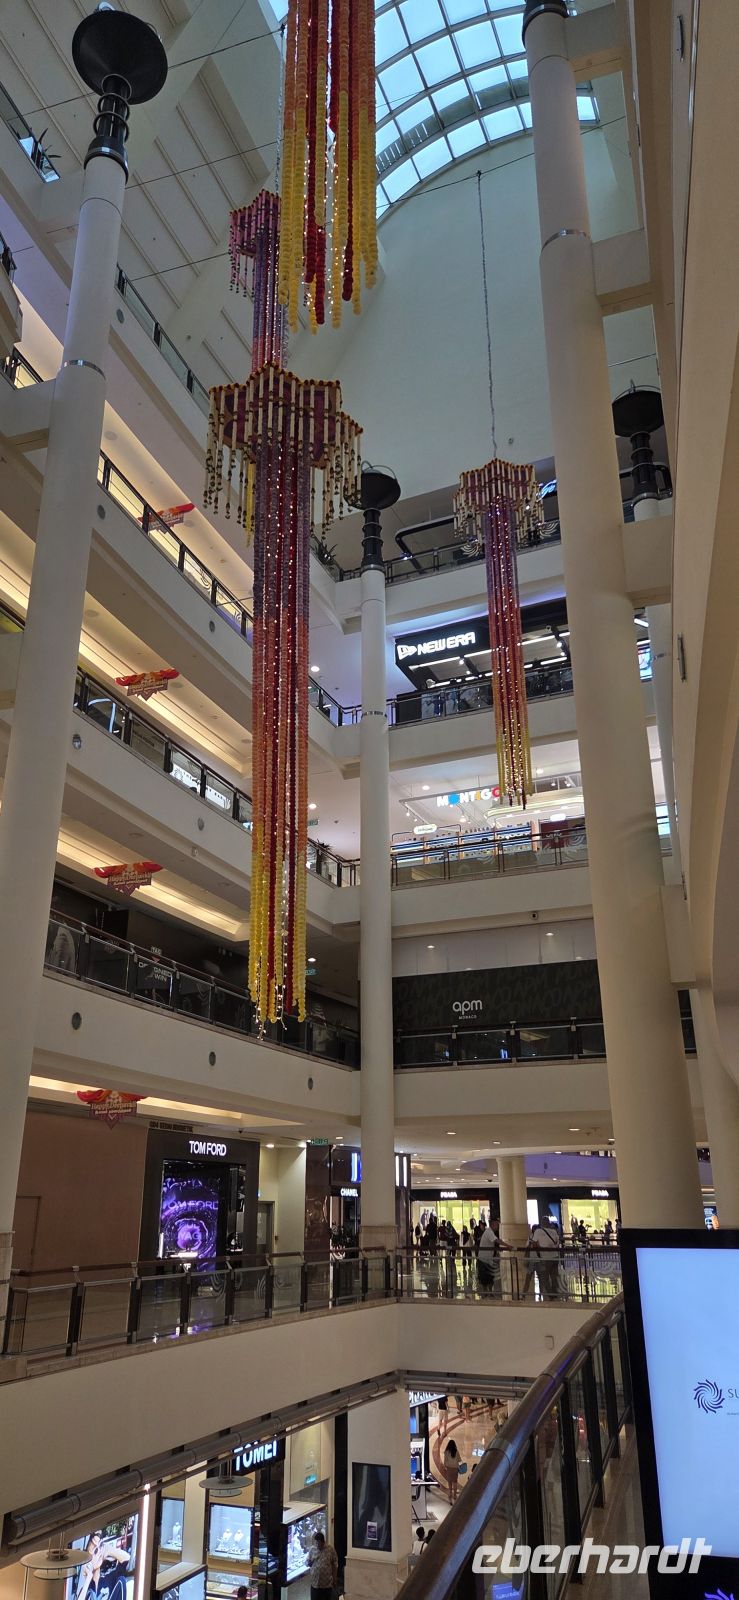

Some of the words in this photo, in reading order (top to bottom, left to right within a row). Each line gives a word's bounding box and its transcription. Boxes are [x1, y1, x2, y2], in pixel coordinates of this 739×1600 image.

[417, 638, 446, 656] NEW
[446, 631, 476, 649] ERA
[452, 1000, 483, 1016] apm
[189, 1140, 206, 1155] TOM
[206, 1142, 227, 1157] FORD
[340, 1187, 359, 1197] CHANEL
[233, 1440, 277, 1472] TOMEI
